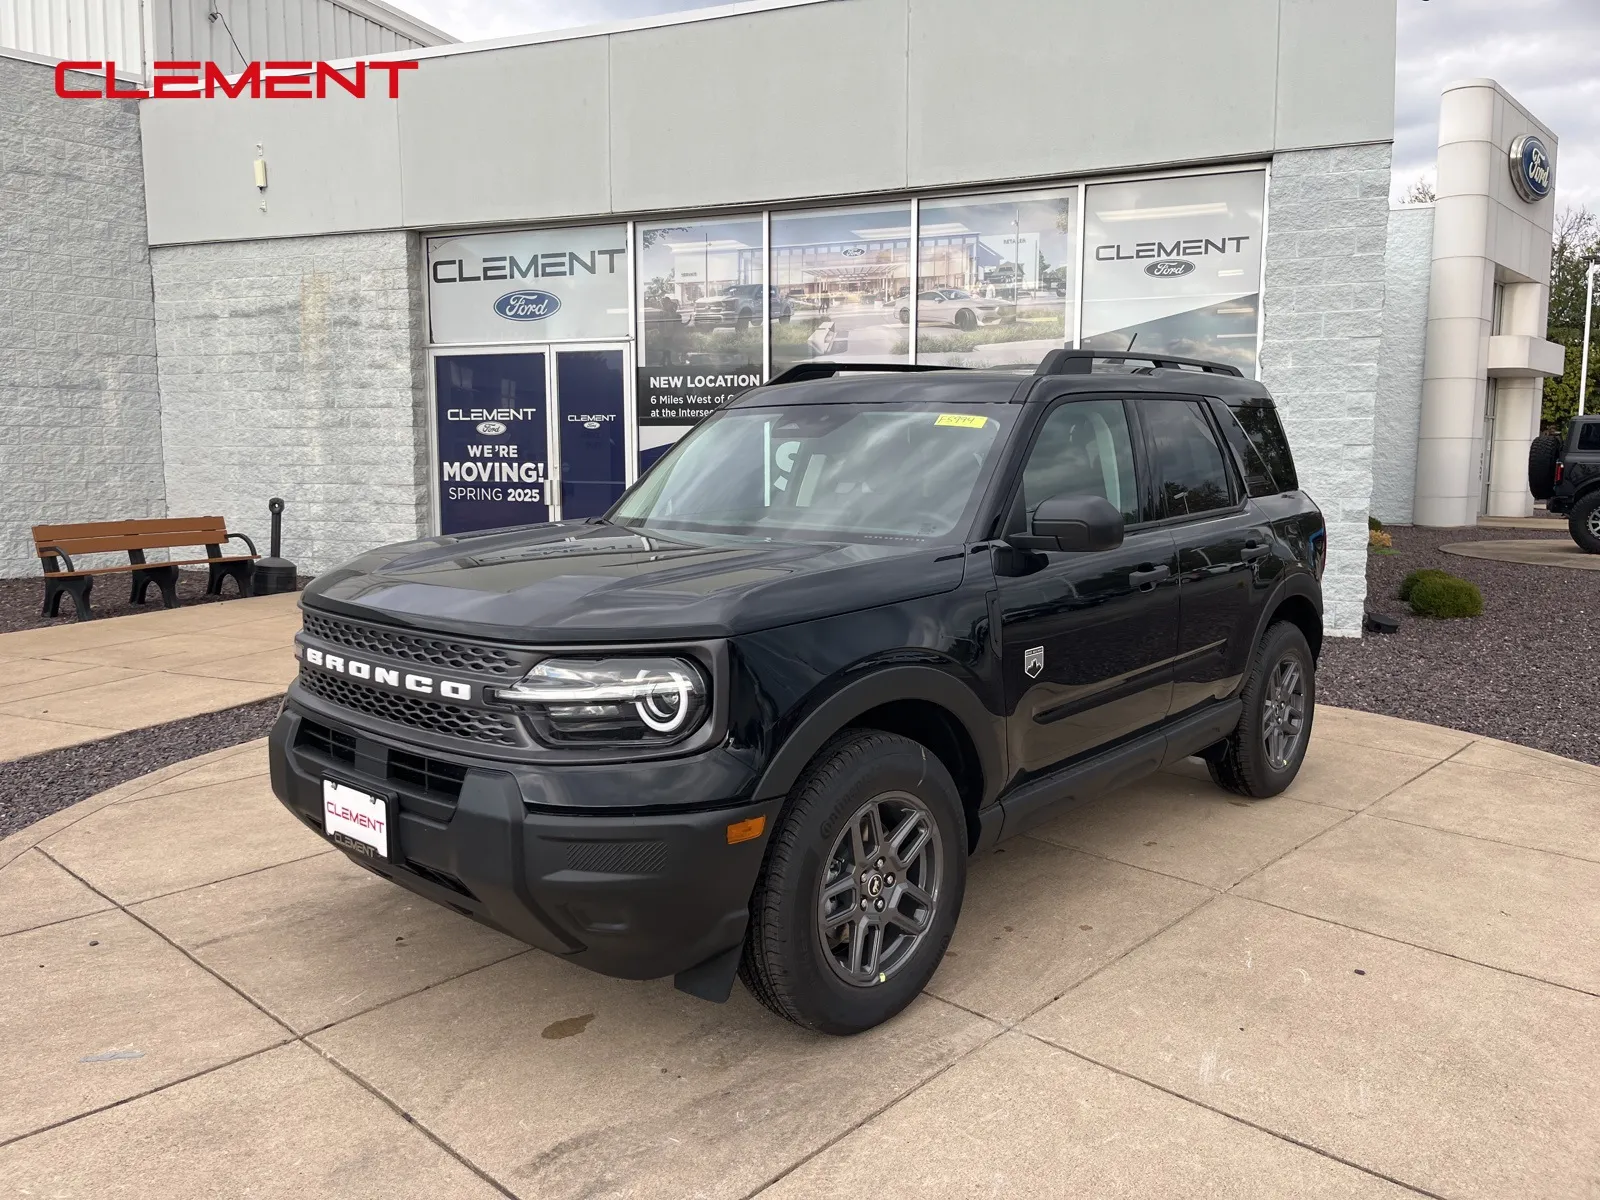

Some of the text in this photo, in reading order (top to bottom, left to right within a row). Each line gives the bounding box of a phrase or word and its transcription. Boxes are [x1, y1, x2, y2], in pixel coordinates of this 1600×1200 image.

[1529, 147, 1549, 187] Ford
[1095, 236, 1250, 261] CLEMENT
[432, 249, 626, 284] CLEMENT
[1153, 262, 1185, 276] Ford
[505, 294, 548, 316] Ford
[649, 374, 760, 389] NEW LOCATION
[650, 395, 657, 405] 6
[659, 394, 684, 405] Miles
[686, 394, 712, 404] West
[714, 394, 725, 404] of
[447, 408, 537, 421] CLEMENT
[567, 414, 617, 422] CLEMENT
[650, 409, 660, 417] at
[662, 408, 677, 417] the
[443, 462, 545, 483] MOVING!
[448, 487, 540, 502] SPRING 2025
[306, 647, 472, 700] BRONCO
[326, 801, 385, 834] CLEMENT
[334, 832, 376, 858] CLEMENT
